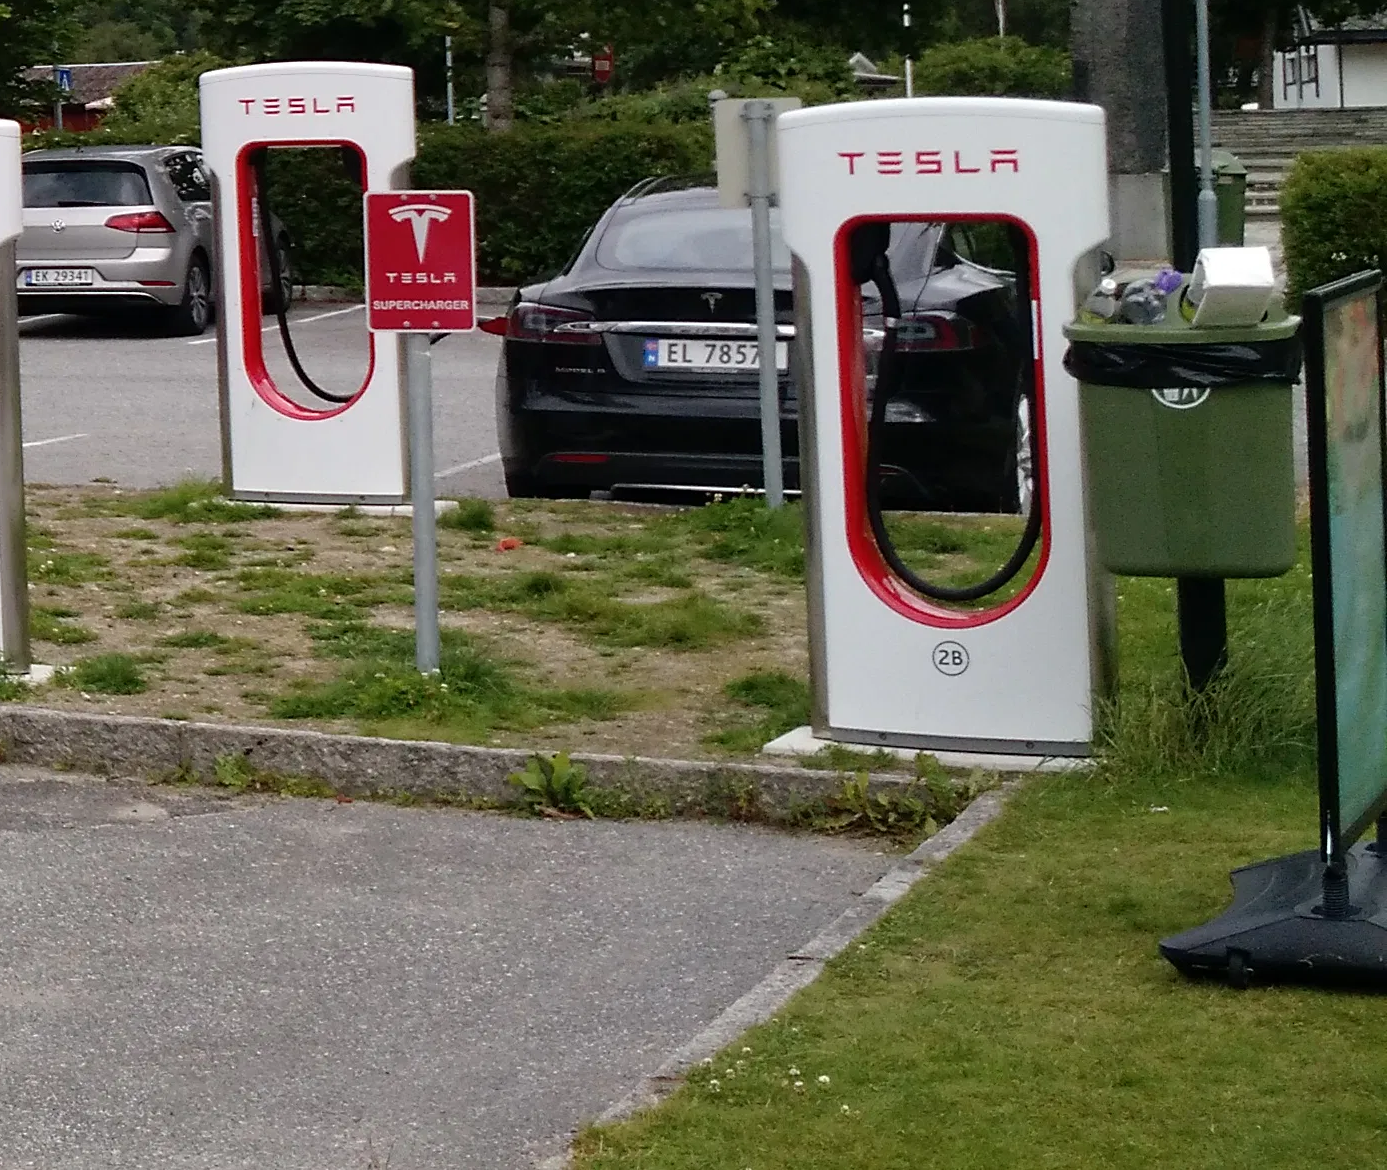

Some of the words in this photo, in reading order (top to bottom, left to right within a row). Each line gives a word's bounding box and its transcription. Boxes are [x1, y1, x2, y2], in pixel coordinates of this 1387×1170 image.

[239, 96, 355, 116] TESLA
[837, 149, 1019, 174] TESLA
[35, 271, 48, 282] EK
[54, 271, 88, 282] 29341
[385, 272, 457, 284] TESLA
[373, 300, 469, 310] SUPERCHARGER
[668, 343, 693, 363] EL
[704, 344, 760, 365] 7857
[938, 649, 964, 666] 2B
